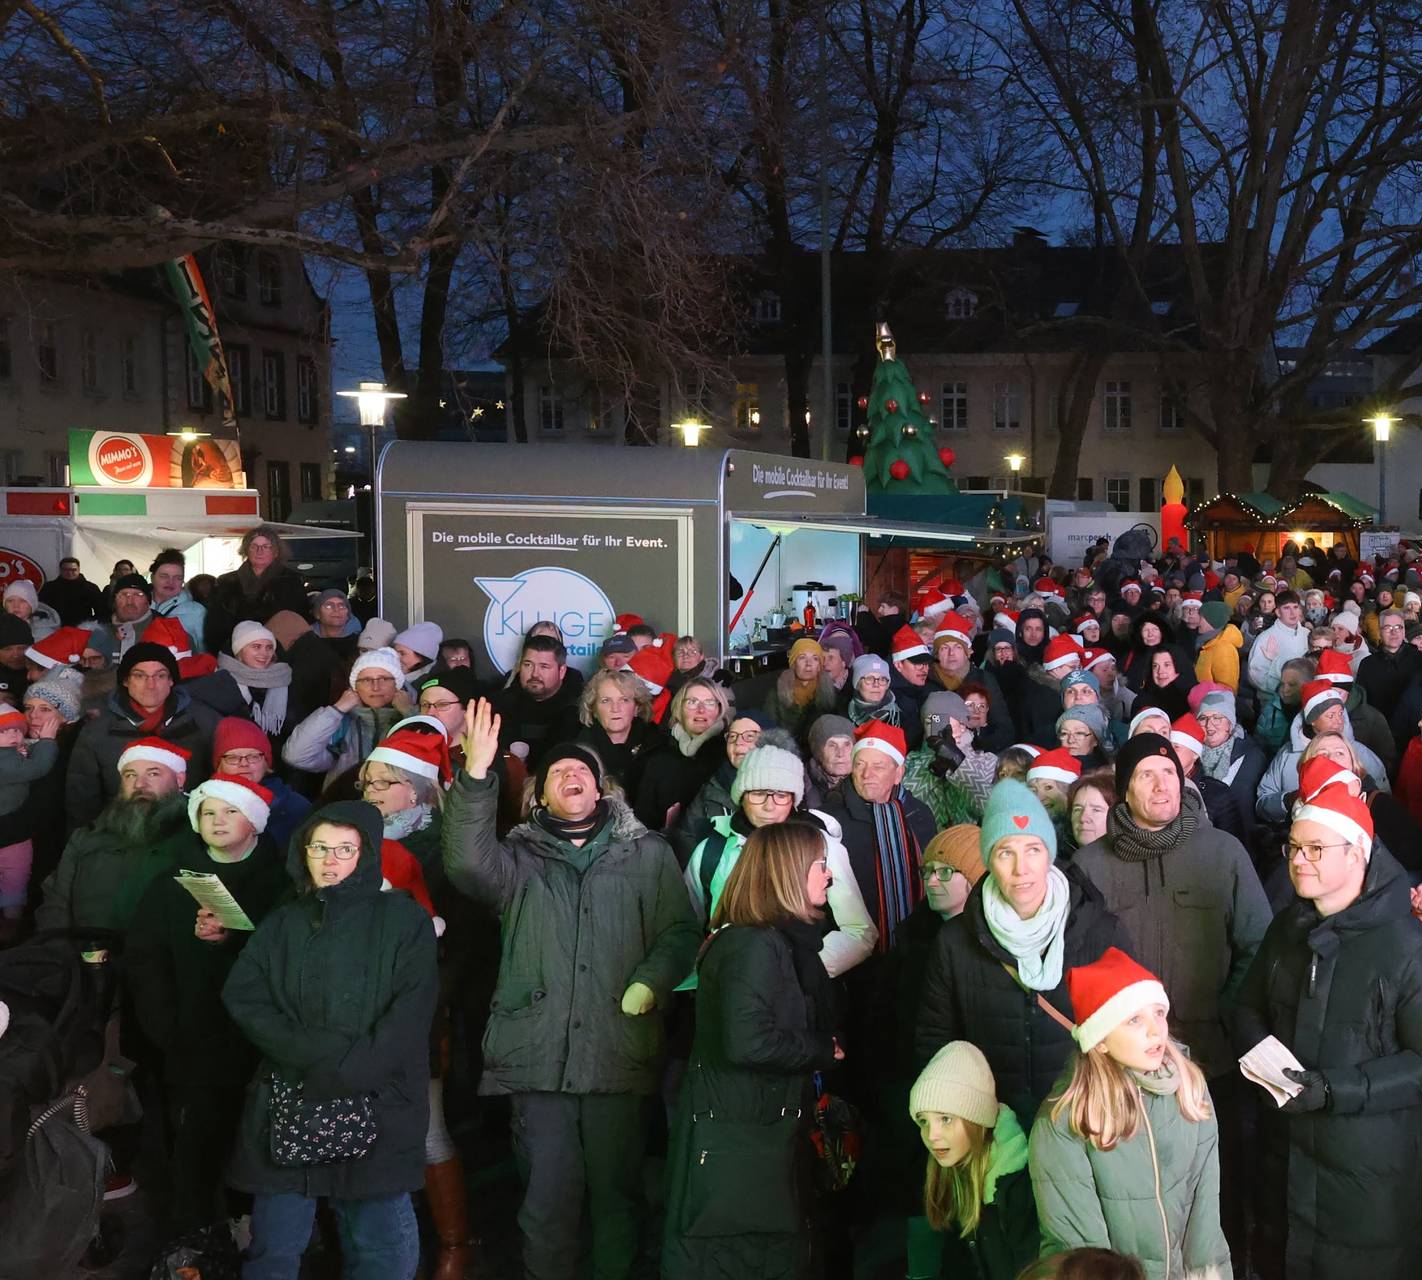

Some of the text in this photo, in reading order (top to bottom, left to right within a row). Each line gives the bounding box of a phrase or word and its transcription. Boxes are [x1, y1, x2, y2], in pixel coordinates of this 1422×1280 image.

[101, 446, 137, 466] MIMMO'S
[753, 464, 764, 484] Die
[765, 466, 785, 485] mobile
[786, 467, 816, 488] Cocktailbar
[432, 532, 668, 548] Die mobile Cocktailbar für Ihr Event.
